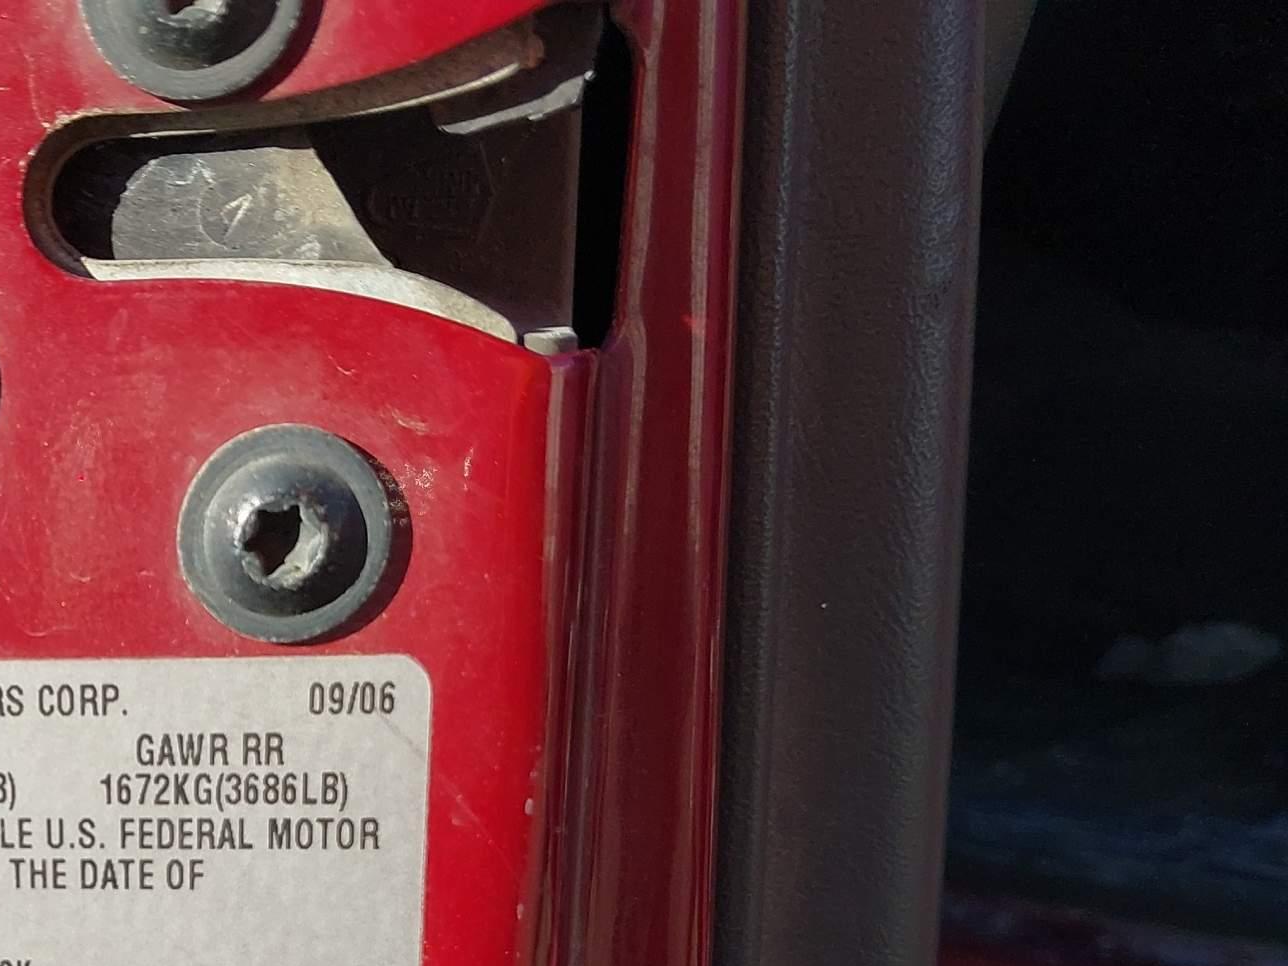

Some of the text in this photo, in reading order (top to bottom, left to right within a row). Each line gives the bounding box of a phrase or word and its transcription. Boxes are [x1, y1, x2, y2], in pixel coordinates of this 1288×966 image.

[39, 684, 127, 716] CORP.
[310, 681, 395, 715] 09/06
[137, 732, 284, 766] GAWR RR
[101, 772, 348, 812] 1672KG(3686LB)
[47, 818, 104, 849] U.S.
[121, 818, 253, 849] FEDERAL
[269, 818, 379, 849] MOTOR
[9, 859, 66, 889] THE
[81, 859, 153, 889] DATE
[167, 859, 203, 890] OF
